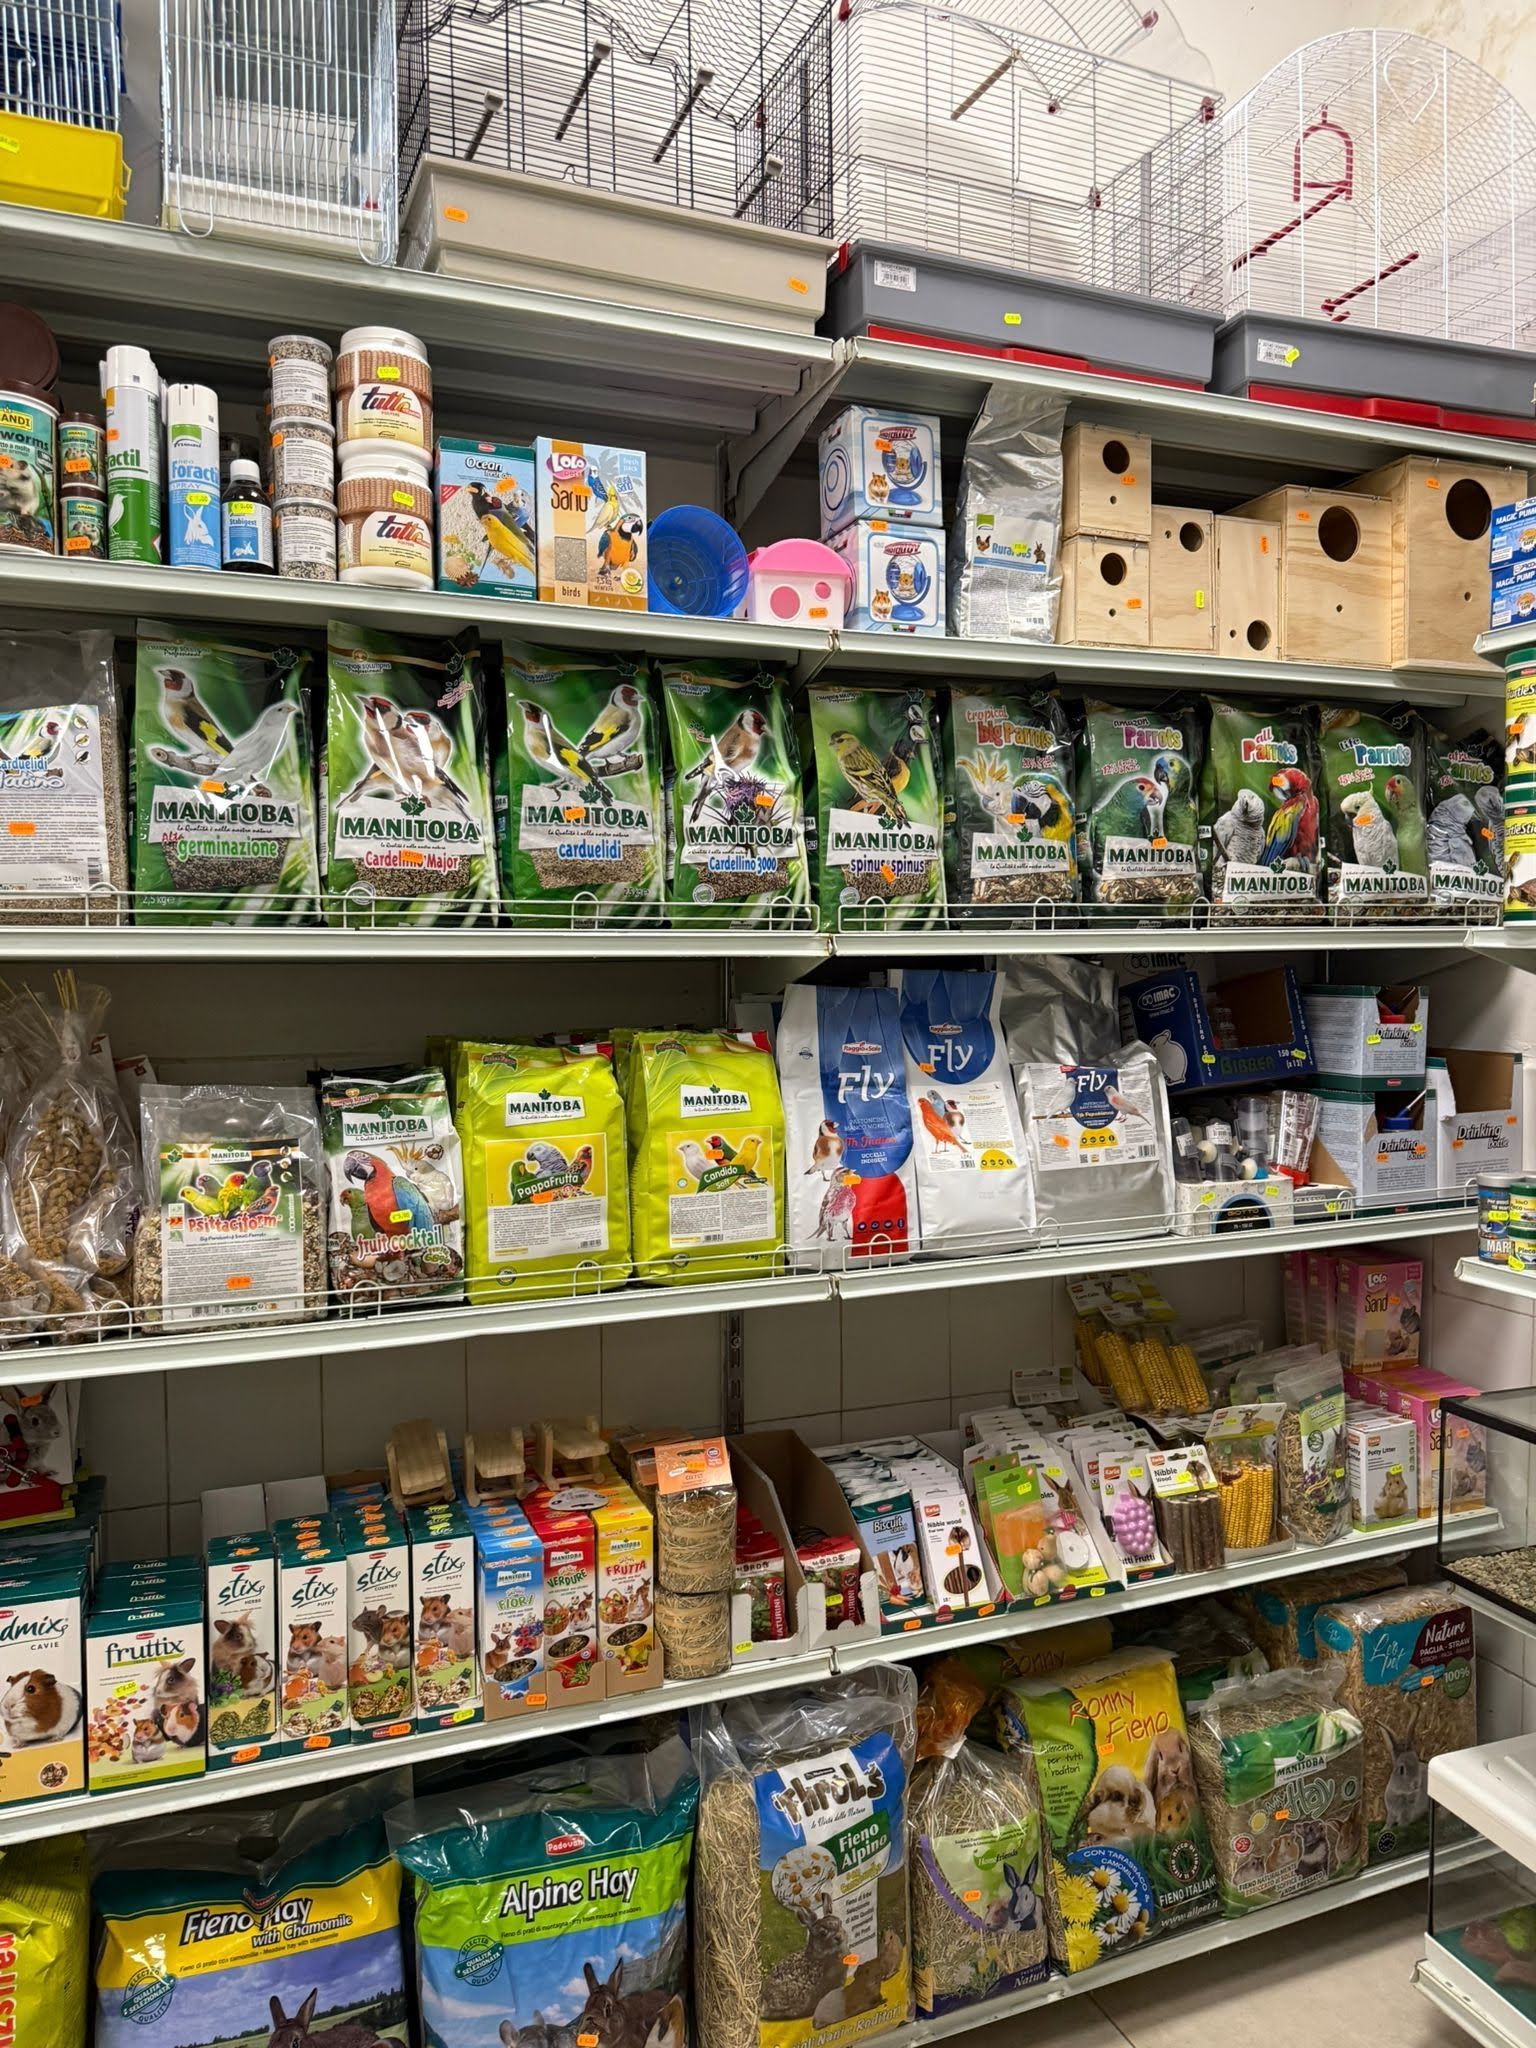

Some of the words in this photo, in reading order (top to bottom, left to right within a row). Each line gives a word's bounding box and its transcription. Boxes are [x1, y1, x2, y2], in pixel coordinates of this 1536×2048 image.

[362, 386, 411, 412] tutto
[465, 456, 504, 472] Ocean
[229, 518, 257, 527] Stabigest
[1496, 513, 1518, 525] MAGIC
[1496, 577, 1515, 589] MAGIC
[1516, 570, 1536, 582] PUMP
[562, 586, 581, 598] birds
[966, 705, 1009, 722] tropical
[1113, 717, 1149, 728] amazon
[977, 720, 1004, 747] big
[1004, 721, 1055, 751] Parrots
[1124, 726, 1183, 750] Parrots
[1255, 727, 1272, 743] all
[1242, 740, 1298, 764] Parrots
[1355, 744, 1412, 766] Parrots
[342, 817, 480, 841] MANITOBA
[688, 825, 794, 846] MANITOBA
[177, 835, 279, 863] germinazione
[557, 839, 622, 860] carduelidi
[834, 831, 935, 850] MANITOBA
[977, 845, 1067, 860] MANITOBA
[1108, 849, 1194, 864] MANITOBA
[425, 853, 460, 874] Major
[709, 856, 756, 872] Cardellino
[757, 856, 778, 872] 3000
[850, 857, 885, 876] spinus
[892, 857, 925, 875] spinus
[1229, 875, 1316, 893] MANITOBA
[1345, 875, 1426, 893] MANITOBA
[1151, 953, 1186, 967] IMAC
[1154, 988, 1176, 1002] IMAC
[1375, 1027, 1412, 1043] Drinking
[927, 1039, 974, 1073] Fly
[1278, 1049, 1290, 1058] 150
[1221, 1055, 1275, 1075] BIBBER
[838, 1065, 895, 1104] Fly
[1077, 1070, 1108, 1093] Fly
[509, 1100, 581, 1114] MANITOBA
[683, 1094, 748, 1108] MANITOBA
[346, 1118, 428, 1135] MANITOBA
[1457, 1122, 1503, 1141] Drinking
[1379, 1138, 1420, 1154] Drinking
[1487, 1137, 1510, 1149] bottle
[211, 1151, 250, 1159] MANITOBA
[703, 1165, 738, 1184] Candido
[517, 1173, 579, 1199] PappaFrutta
[357, 1233, 388, 1260] fruit
[390, 1224, 443, 1252] cocktail
[1364, 1293, 1389, 1314] Sand
[1153, 1468, 1178, 1477] Nibble
[1156, 1475, 1172, 1483] Wood
[873, 1515, 904, 1534] Biscuit
[947, 1518, 962, 1526] wood
[421, 1550, 466, 1582] stix
[1134, 1552, 1156, 1563] Frutti
[356, 1559, 402, 1592] stix
[547, 1568, 588, 1588] VERDURE
[605, 1560, 647, 1578] FRUTTA
[218, 1572, 265, 1606] stix
[291, 1574, 338, 1608] stix
[374, 1583, 398, 1592] COUNTRY
[497, 1594, 535, 1610] FIORI
[127, 1610, 166, 1621] fruttix
[1424, 1619, 1467, 1647] Nature
[31, 1642, 60, 1651] CAVIE
[104, 1637, 185, 1669] fruttix
[1419, 1644, 1445, 1657] PAGLIA
[1448, 1636, 1472, 1650] STRAW
[1444, 1665, 1471, 1684] 100%
[1068, 1689, 1137, 1727] Ronny
[1105, 1711, 1170, 1744] Fieno
[1040, 1742, 1075, 1754] Alimento
[1046, 1757, 1060, 1769] per
[1064, 1754, 1084, 1763] tutti
[1051, 1763, 1081, 1777] roditori
[1276, 1755, 1326, 1778] MANITOBA
[1286, 1776, 1336, 1821] Hay
[838, 1823, 880, 1853] Fieno
[841, 1833, 889, 1871] Alpino
[995, 1849, 1019, 1863] friends
[1083, 1849, 1106, 1858] CON
[1108, 1850, 1148, 1893] TARASSACO
[1101, 1857, 1139, 1890] CAMOMILLA
[499, 1875, 584, 1924] Alpine
[587, 1864, 640, 1903] Hay
[1238, 1879, 1257, 1892] FIENO
[1159, 1889, 1185, 1907] FIENO
[178, 1908, 255, 1947] Fieno
[260, 1898, 314, 1933] Hay
[1160, 1899, 1219, 1928] www.allpet.it
[252, 1928, 281, 1949] with
[284, 1914, 353, 1941] Chamomile
[309, 1933, 339, 1944] chamomile
[462, 1938, 490, 1956] SELECTED
[461, 1951, 501, 1976] SELEZIONATA
[471, 1968, 498, 1985] QUALITY
[137, 2001, 169, 2023] QUALITY
